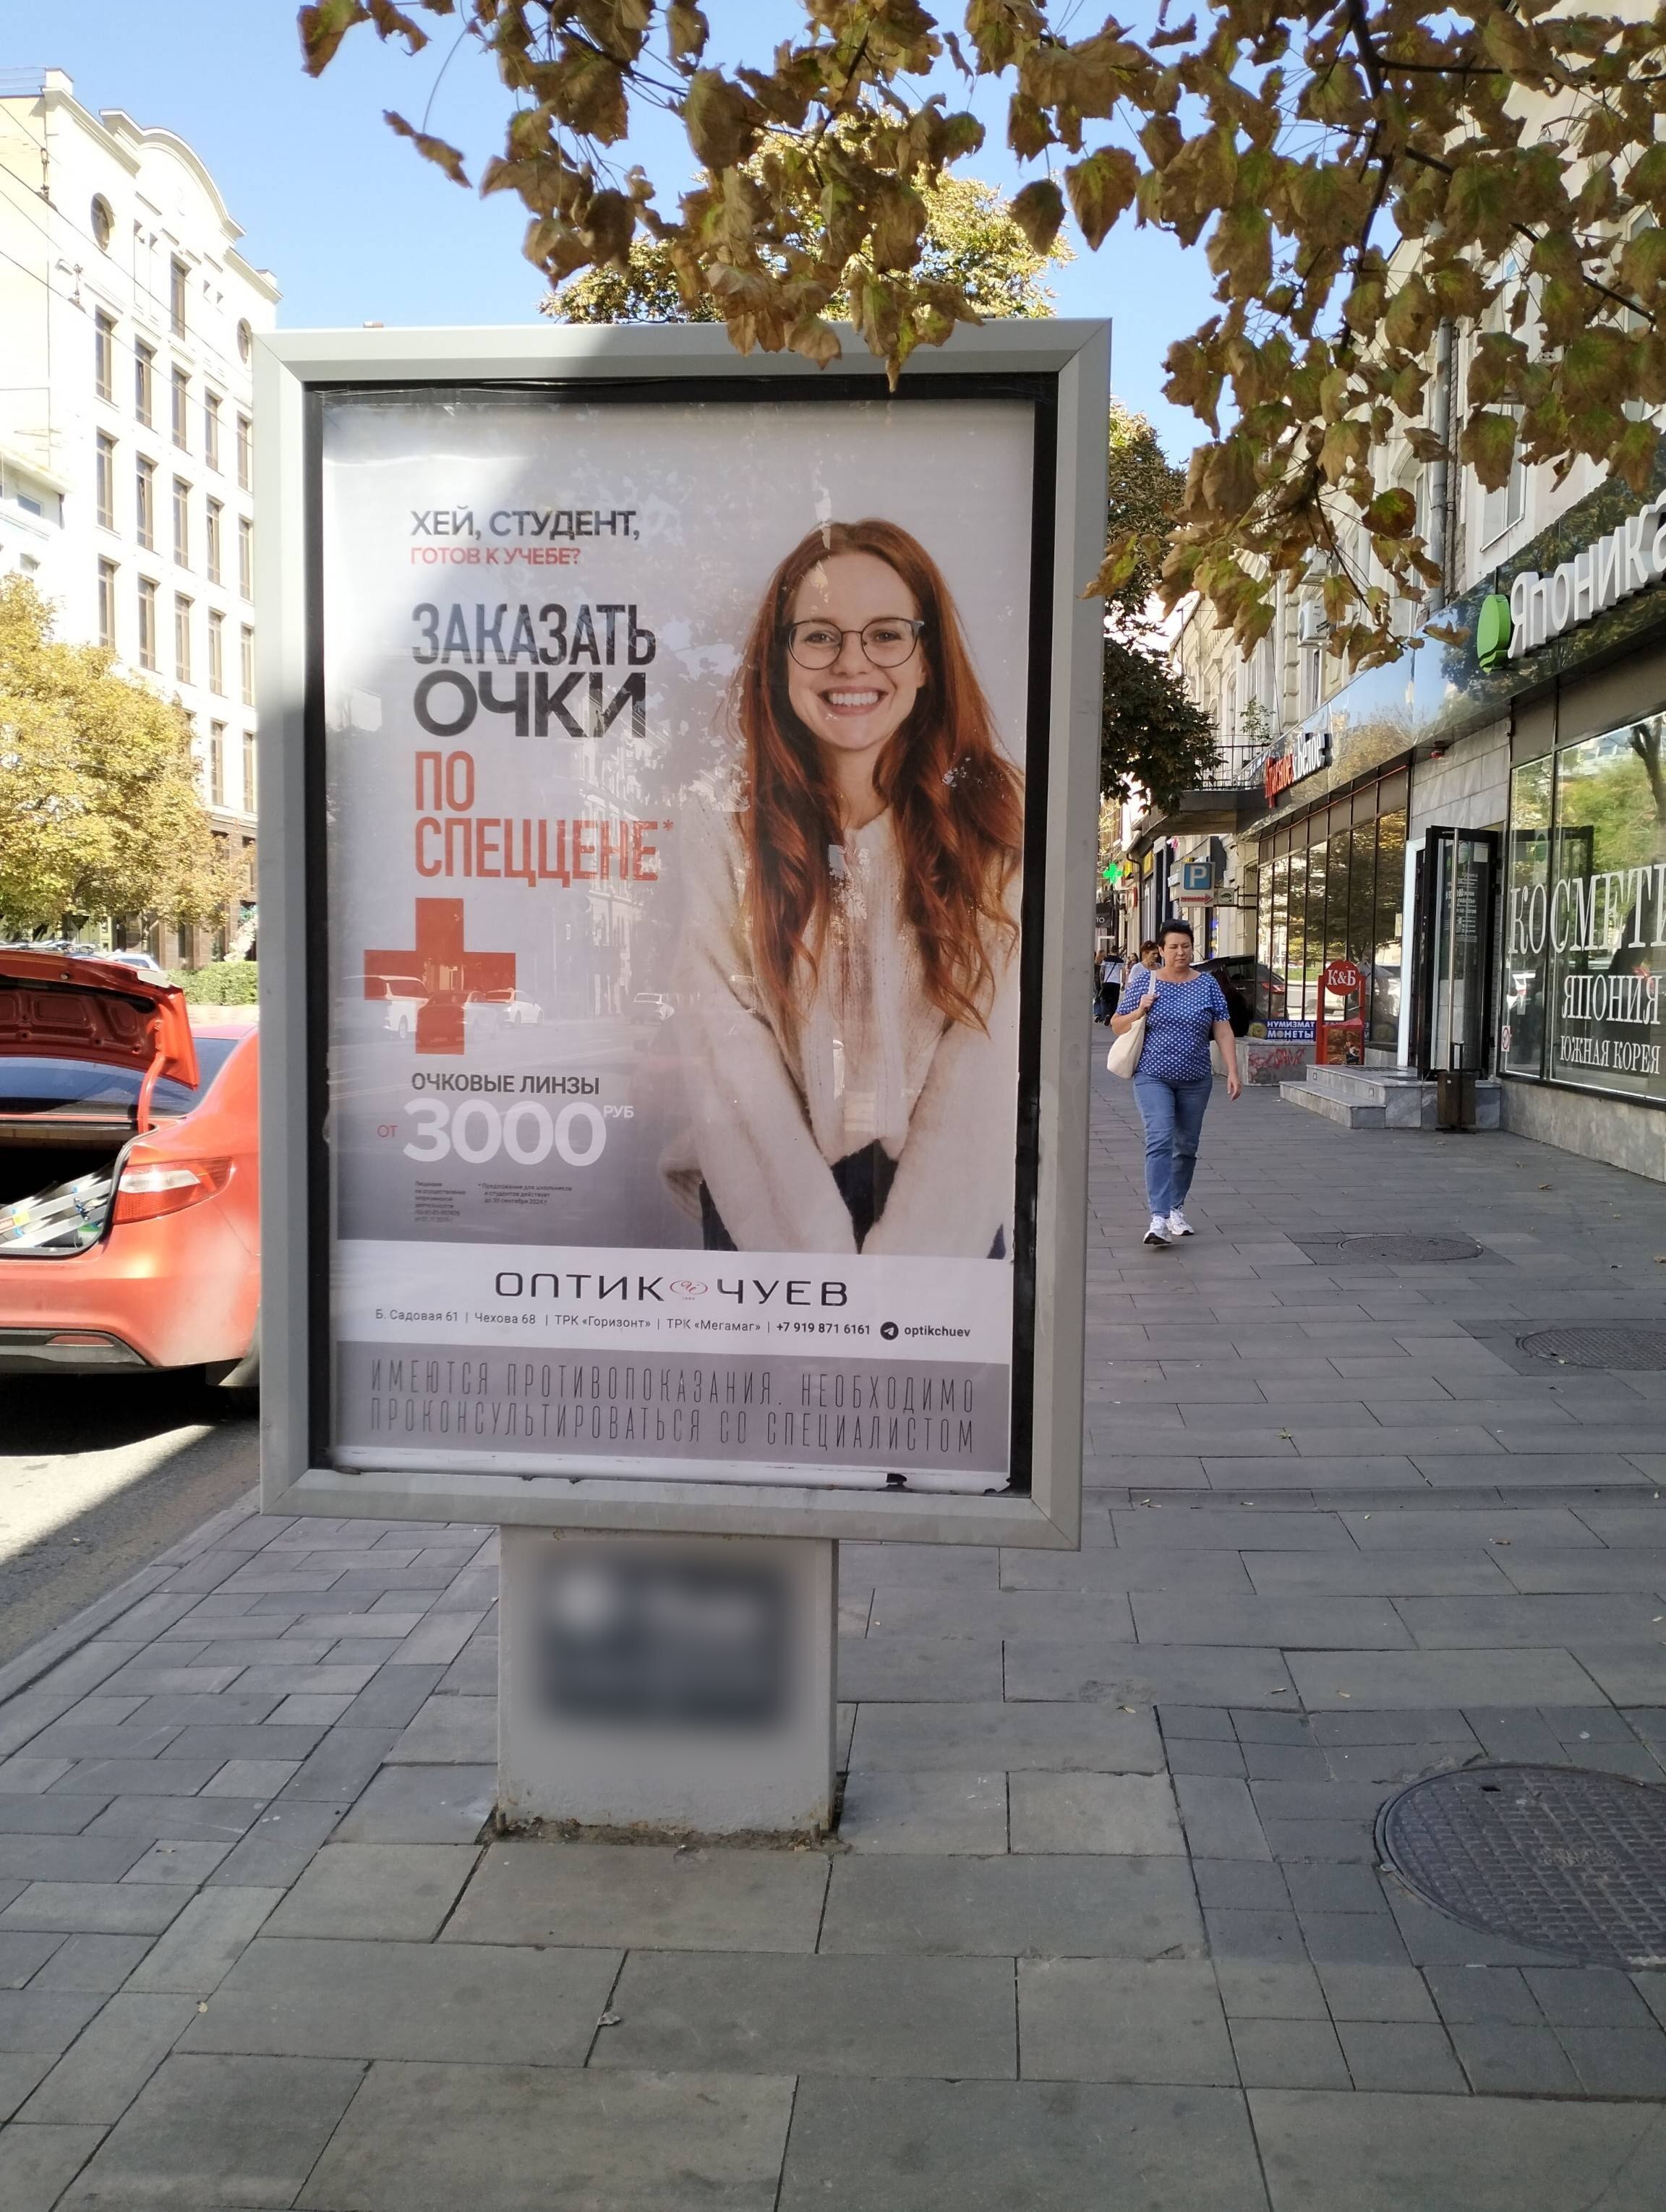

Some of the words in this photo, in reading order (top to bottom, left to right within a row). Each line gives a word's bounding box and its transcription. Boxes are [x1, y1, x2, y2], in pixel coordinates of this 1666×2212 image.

[411, 505, 481, 540] ХЕЙ,
[489, 510, 640, 540] СТУДЕНТ,
[411, 547, 480, 565] ГОТОВ
[487, 548, 499, 565] К
[504, 547, 581, 565] УЧЕБЕ?
[411, 602, 656, 666] ЗАКАЗАТЬ
[414, 669, 646, 738] ОЧКИ
[415, 750, 474, 812] ПО
[1189, 866, 1207, 888] P
[1327, 969, 1356, 986] К&Б
[1562, 974, 1662, 1025] ЯПОНИЯ
[1560, 1035, 1610, 1067] ЮЖНАЯ
[1612, 1041, 1661, 1075] КОРЕЯ
[411, 1073, 515, 1093] ОЧКОВЫЕ
[520, 1076, 599, 1094] ЛИНЗЫ
[377, 1124, 398, 1138] ОТ
[403, 1097, 607, 1167] 3000
[604, 1105, 634, 1119] РУБ
[495, 1272, 665, 1301] ОПТИК
[717, 1279, 848, 1307] ЧУЕВ
[375, 1309, 387, 1320] Б.
[390, 1309, 442, 1322] Садовая
[445, 1311, 458, 1321] 61
[474, 1312, 518, 1324] Чехова
[521, 1314, 536, 1324] 68
[555, 1315, 578, 1326] ТРК
[582, 1316, 651, 1329] «Горизонт»
[667, 1319, 691, 1330] ТРК
[694, 1319, 761, 1332] «Мегамаг»
[776, 1322, 790, 1332] +7
[793, 1322, 815, 1334] 919
[818, 1323, 840, 1334] 871
[843, 1324, 871, 1335] 6161
[904, 1325, 970, 1338] optikchuev
[371, 1359, 488, 1395] ИМЕЮТСЯ
[802, 1373, 973, 1414] НЕОБХОДИМО
[371, 1397, 699, 1442] ПРОКОНСУЛЬТИРОВАТЬСЯ
[720, 1410, 747, 1444] СО
[767, 1412, 973, 1453] СПЕЦИАЛИСТОМ
